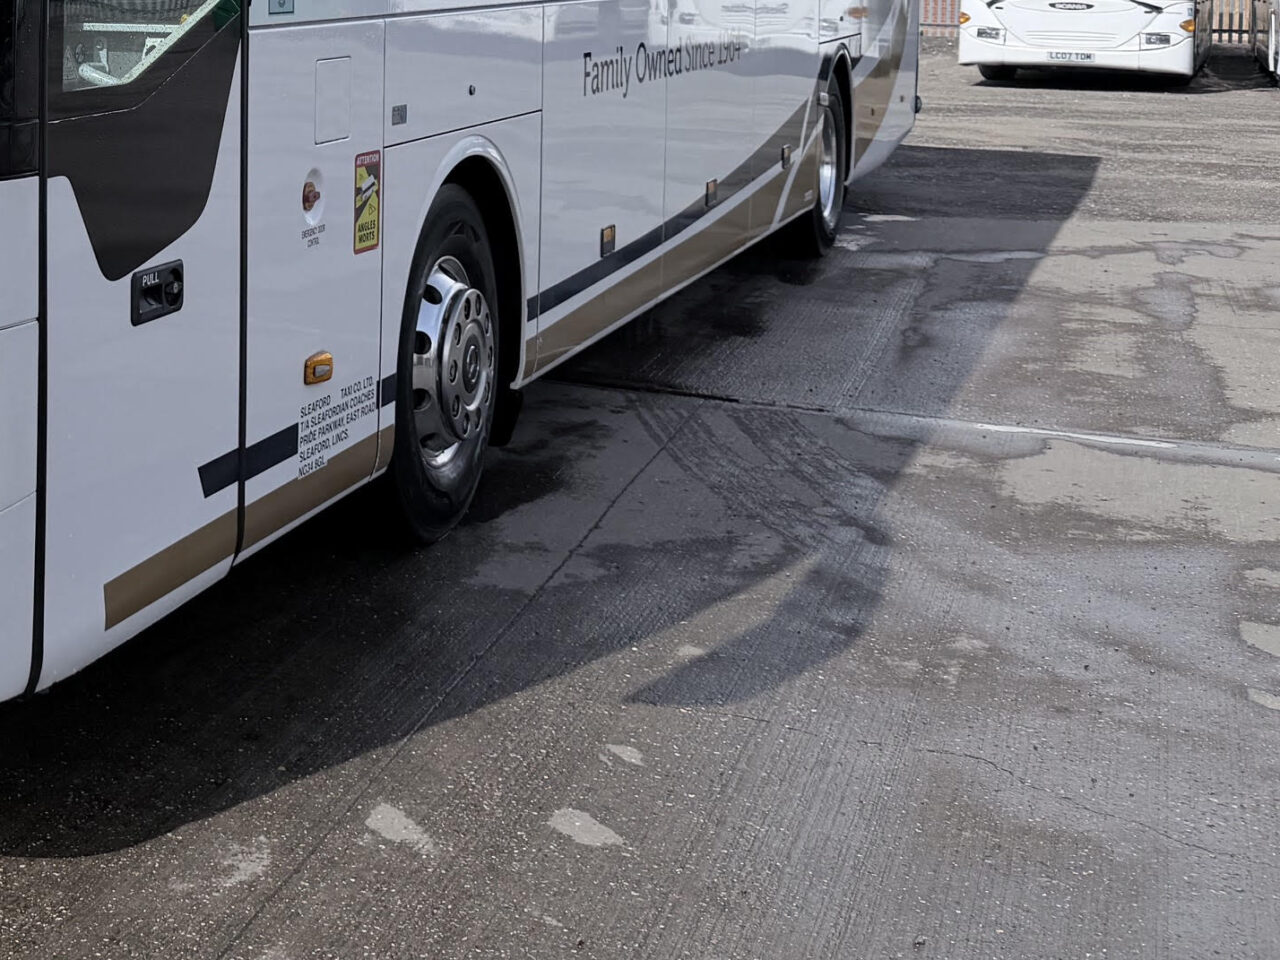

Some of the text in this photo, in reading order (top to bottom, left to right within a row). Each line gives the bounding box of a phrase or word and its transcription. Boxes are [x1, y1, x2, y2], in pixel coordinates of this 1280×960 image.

[582, 46, 633, 98] Family
[635, 36, 683, 84] Owned
[685, 33, 715, 73] Since
[357, 154, 379, 166] ATTENTION
[357, 219, 376, 233] ANGLES
[358, 230, 376, 244] MORTS
[142, 271, 160, 287] PULL
[300, 394, 331, 418] SLEAFORD
[340, 385, 353, 399] TAXI
[363, 375, 374, 389] LTD.
[310, 400, 349, 428] SLEAFORDIAN
[349, 388, 375, 408] COACHES
[300, 429, 317, 448] PRIDE
[346, 409, 360, 424] EAST
[360, 401, 376, 418] ROAD
